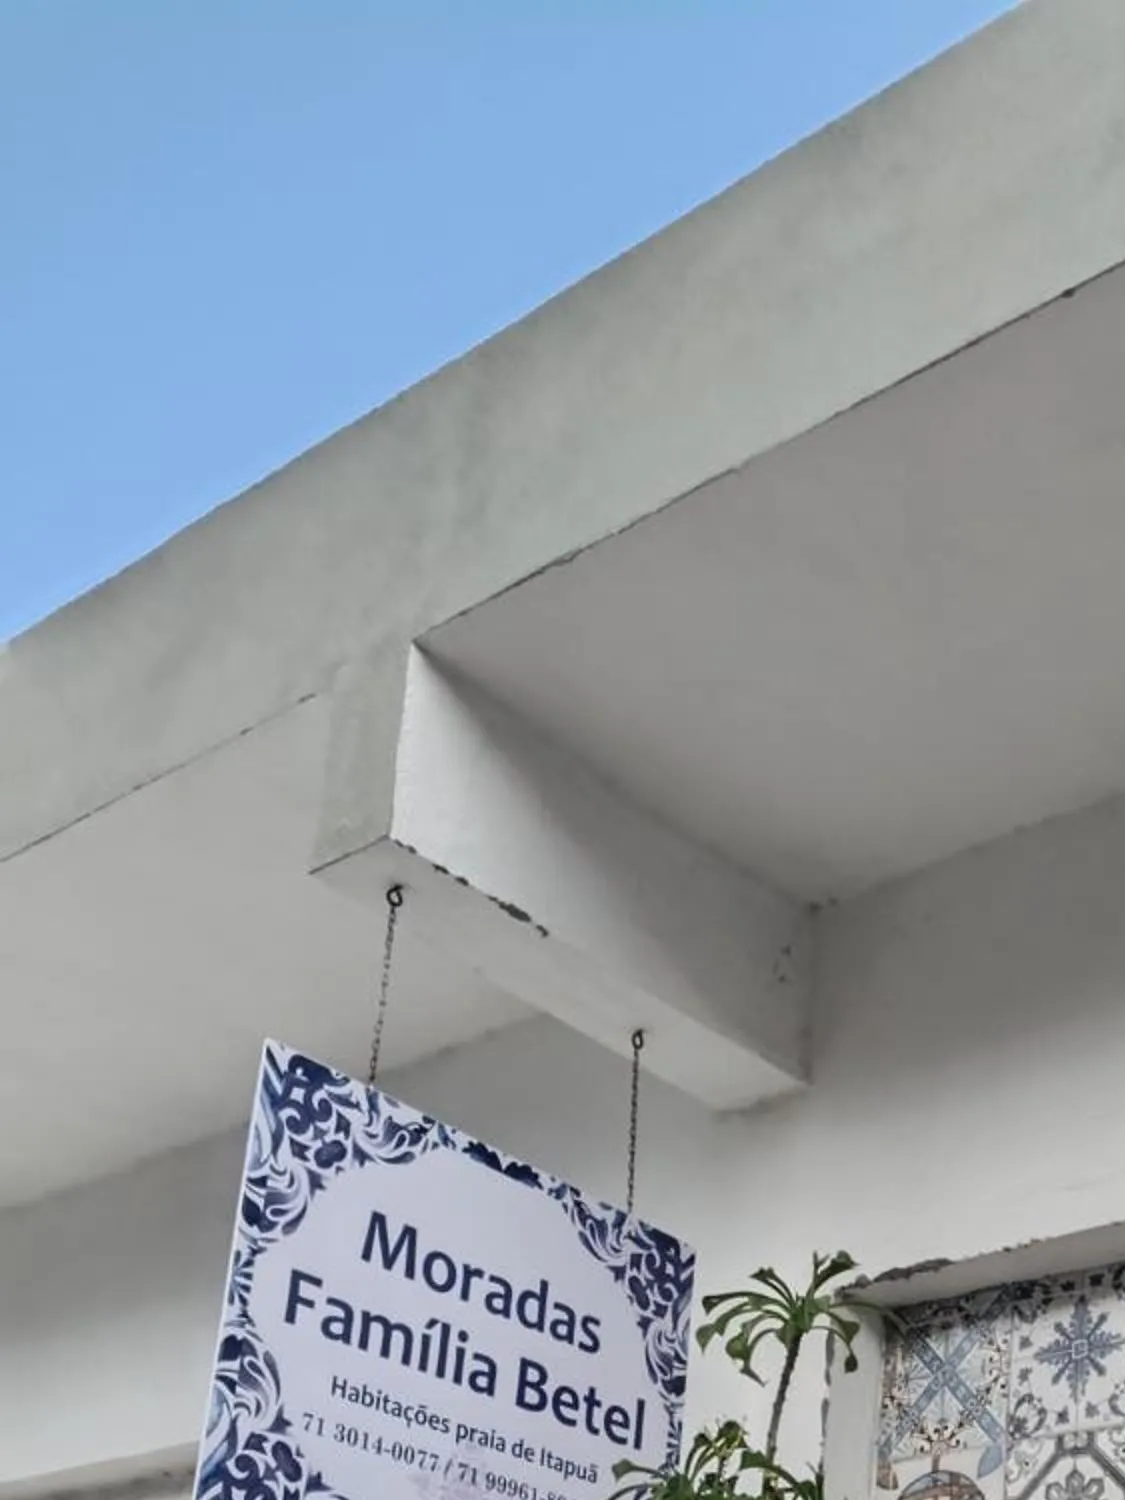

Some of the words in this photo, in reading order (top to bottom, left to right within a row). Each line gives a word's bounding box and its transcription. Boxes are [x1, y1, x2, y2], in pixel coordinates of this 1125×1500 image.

[361, 1210, 601, 1354] Moradas
[284, 1268, 498, 1397] Família
[515, 1357, 646, 1451] Betel
[302, 1412, 325, 1437] 71
[334, 1423, 440, 1472] 3014-0077
[457, 1462, 478, 1487] 71
[331, 1375, 451, 1434] Habitações
[455, 1423, 506, 1453] praia
[511, 1438, 535, 1463] de
[539, 1447, 599, 1483] Itapuã
